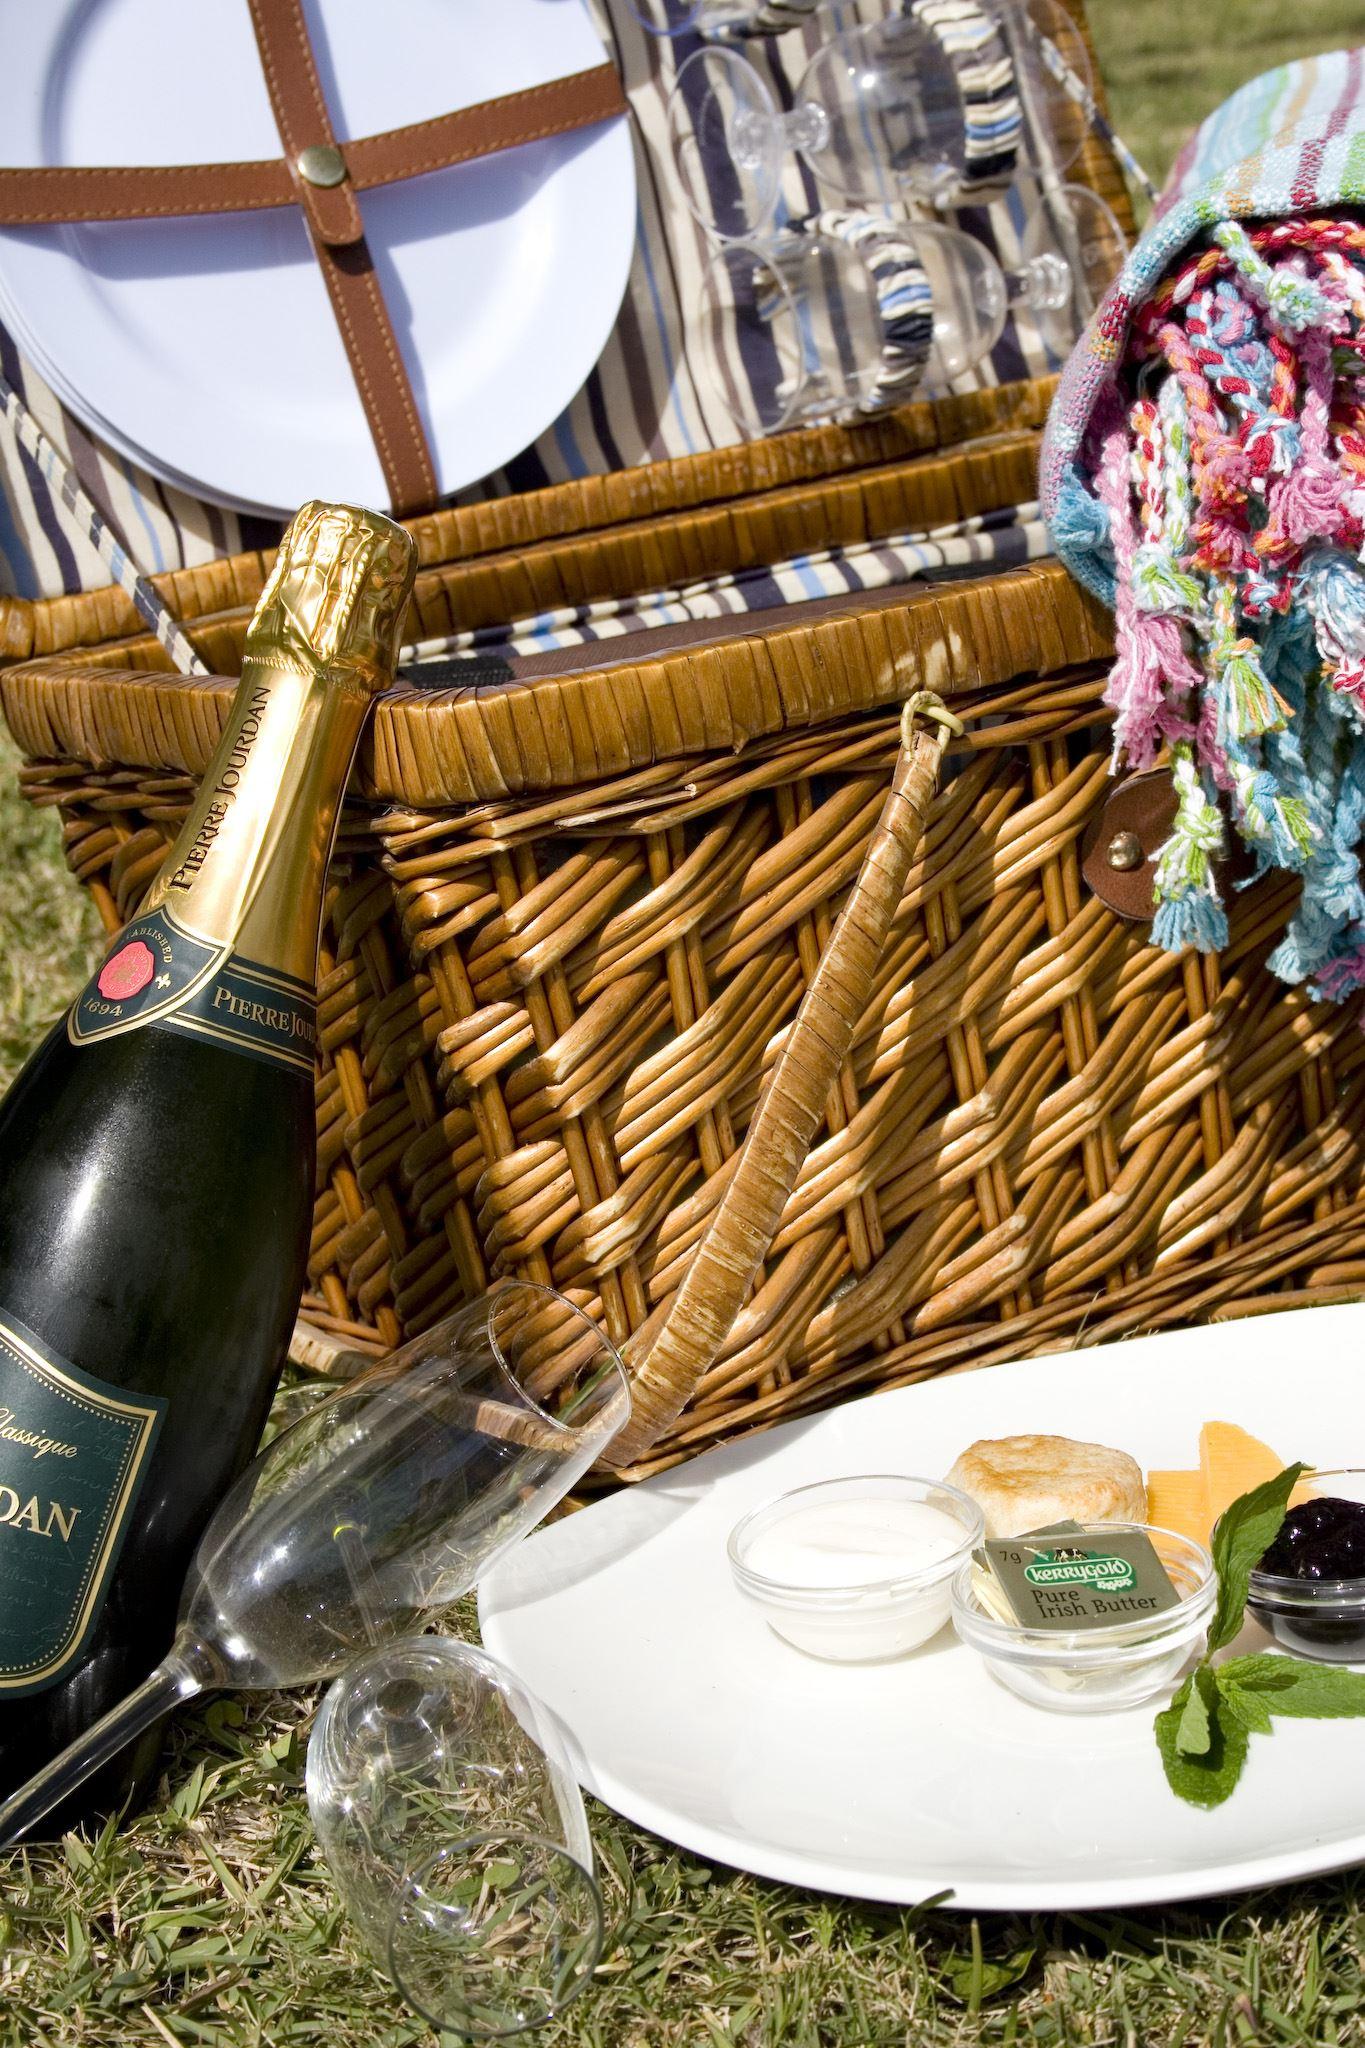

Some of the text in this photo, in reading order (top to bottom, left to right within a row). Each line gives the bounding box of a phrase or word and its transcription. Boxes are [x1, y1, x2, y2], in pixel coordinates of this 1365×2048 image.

[169, 686, 272, 891] PIERRE JOURDAN
[83, 997, 123, 1018] 1694
[211, 985, 290, 1031] PIERRE
[1001, 1550, 1022, 1565] 7g
[1031, 1589, 1081, 1604] Pure
[1036, 1595, 1158, 1619] Irish Butter
